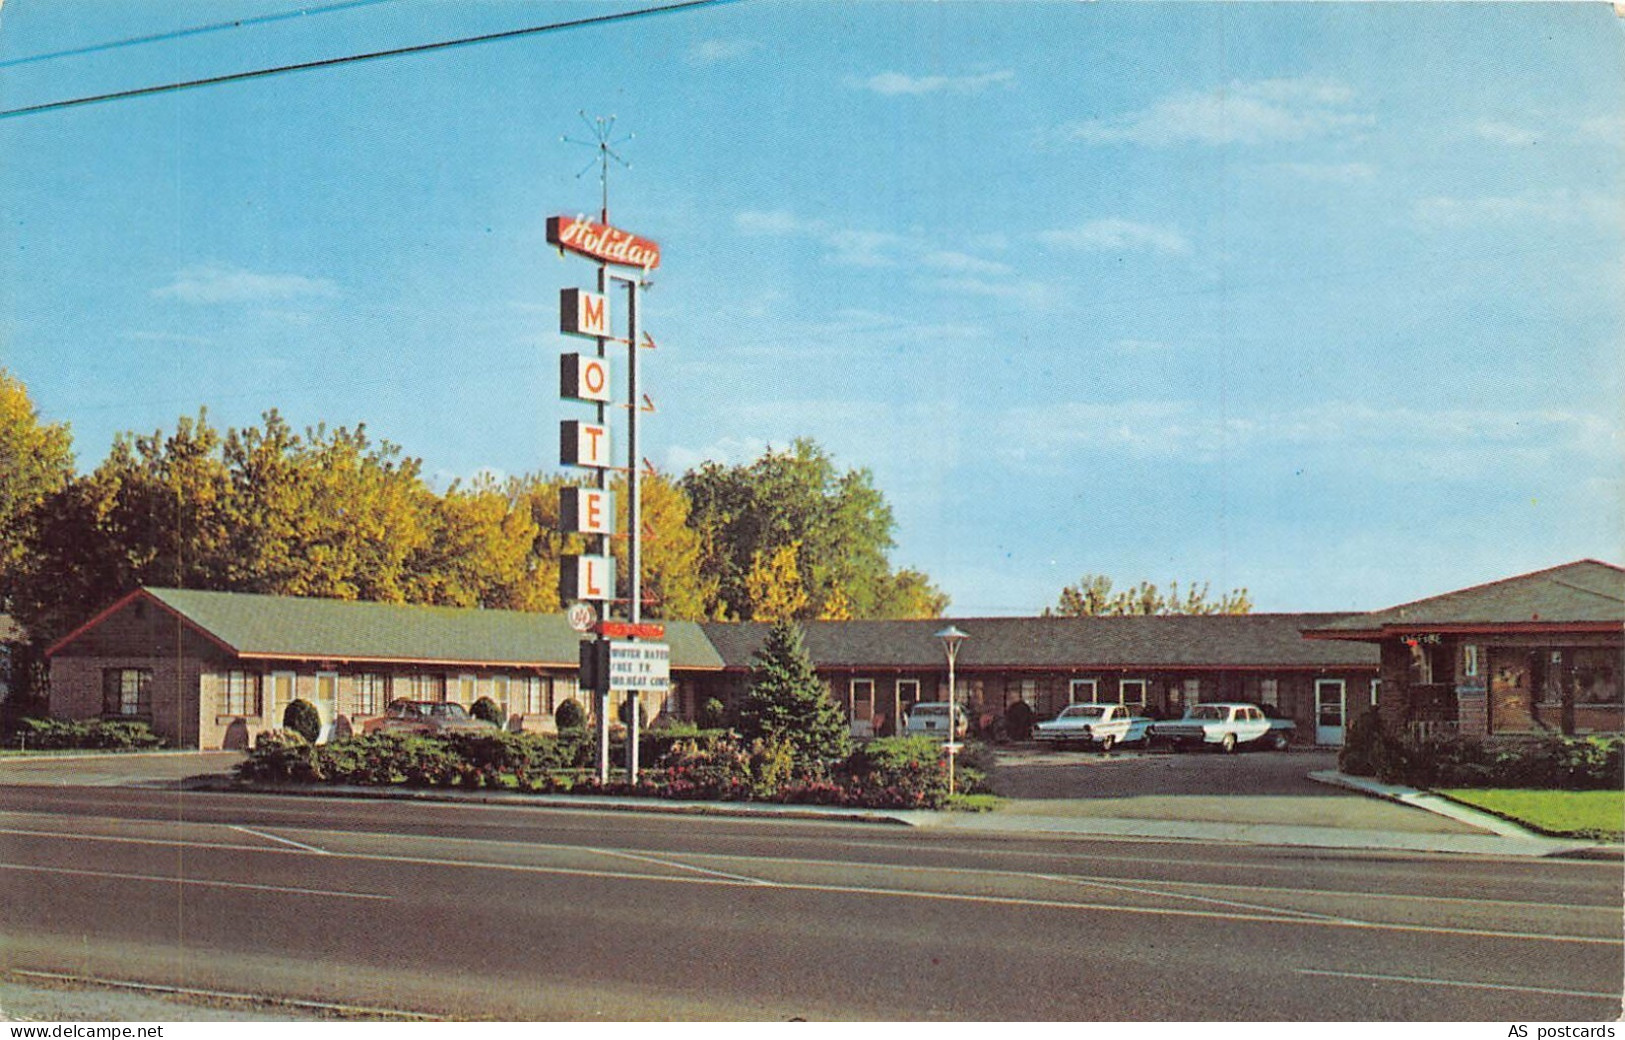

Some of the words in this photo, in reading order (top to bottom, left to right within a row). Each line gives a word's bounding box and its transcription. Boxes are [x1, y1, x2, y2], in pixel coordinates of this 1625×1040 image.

[560, 212, 658, 275] Holiday
[584, 294, 605, 596] MOTEL
[611, 662, 632, 673] FREE
